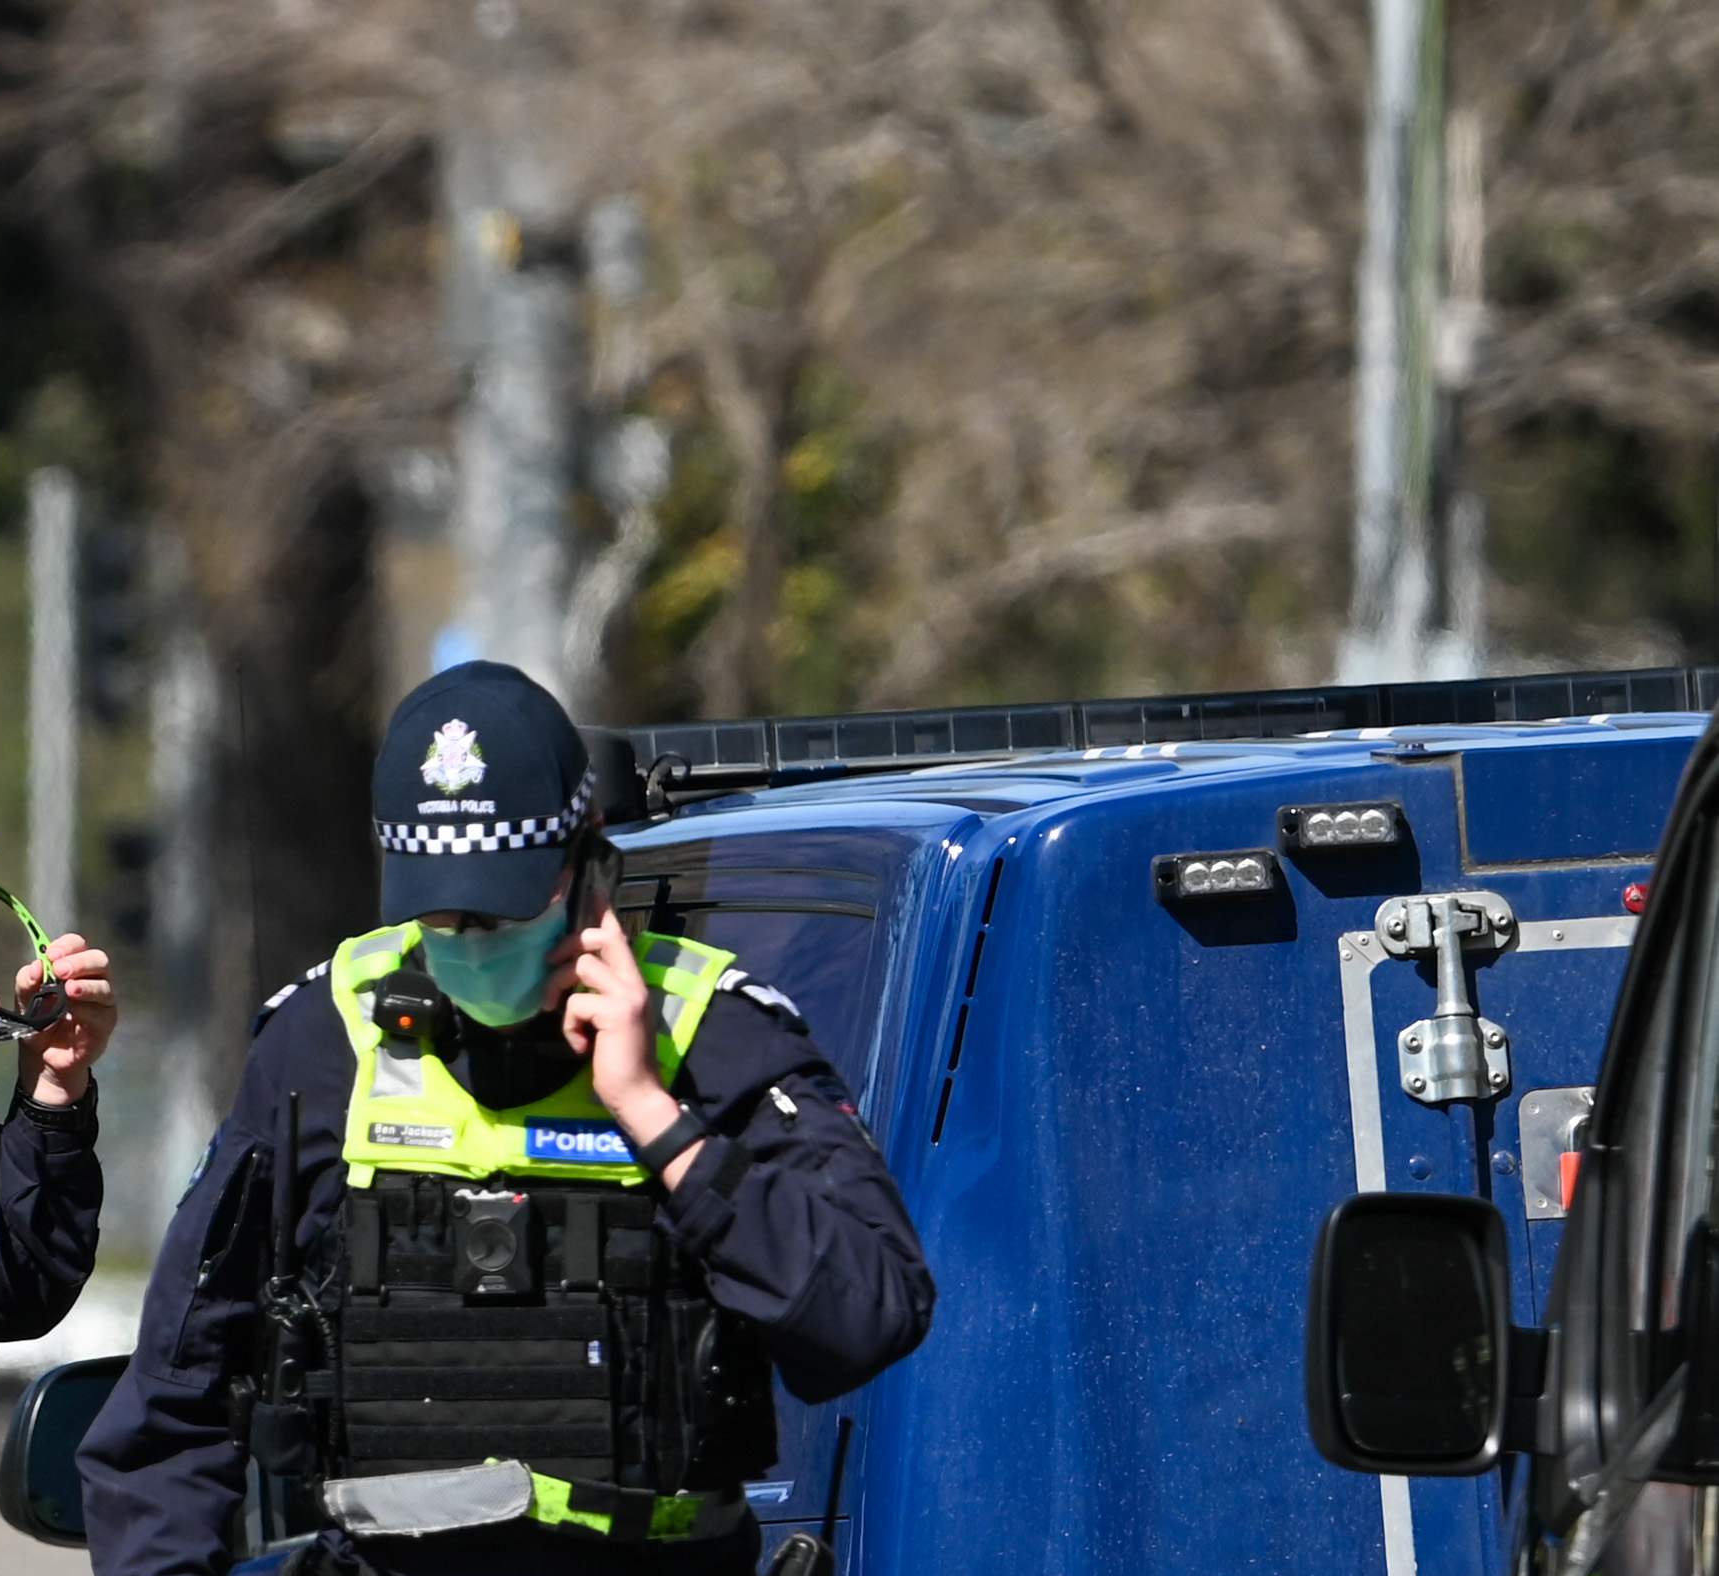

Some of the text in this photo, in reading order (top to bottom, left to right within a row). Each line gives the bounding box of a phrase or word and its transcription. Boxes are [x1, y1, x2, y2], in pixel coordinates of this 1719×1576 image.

[460, 799, 496, 814] POLICE
[374, 1122, 396, 1135] Ben
[535, 1128, 629, 1153] Police
